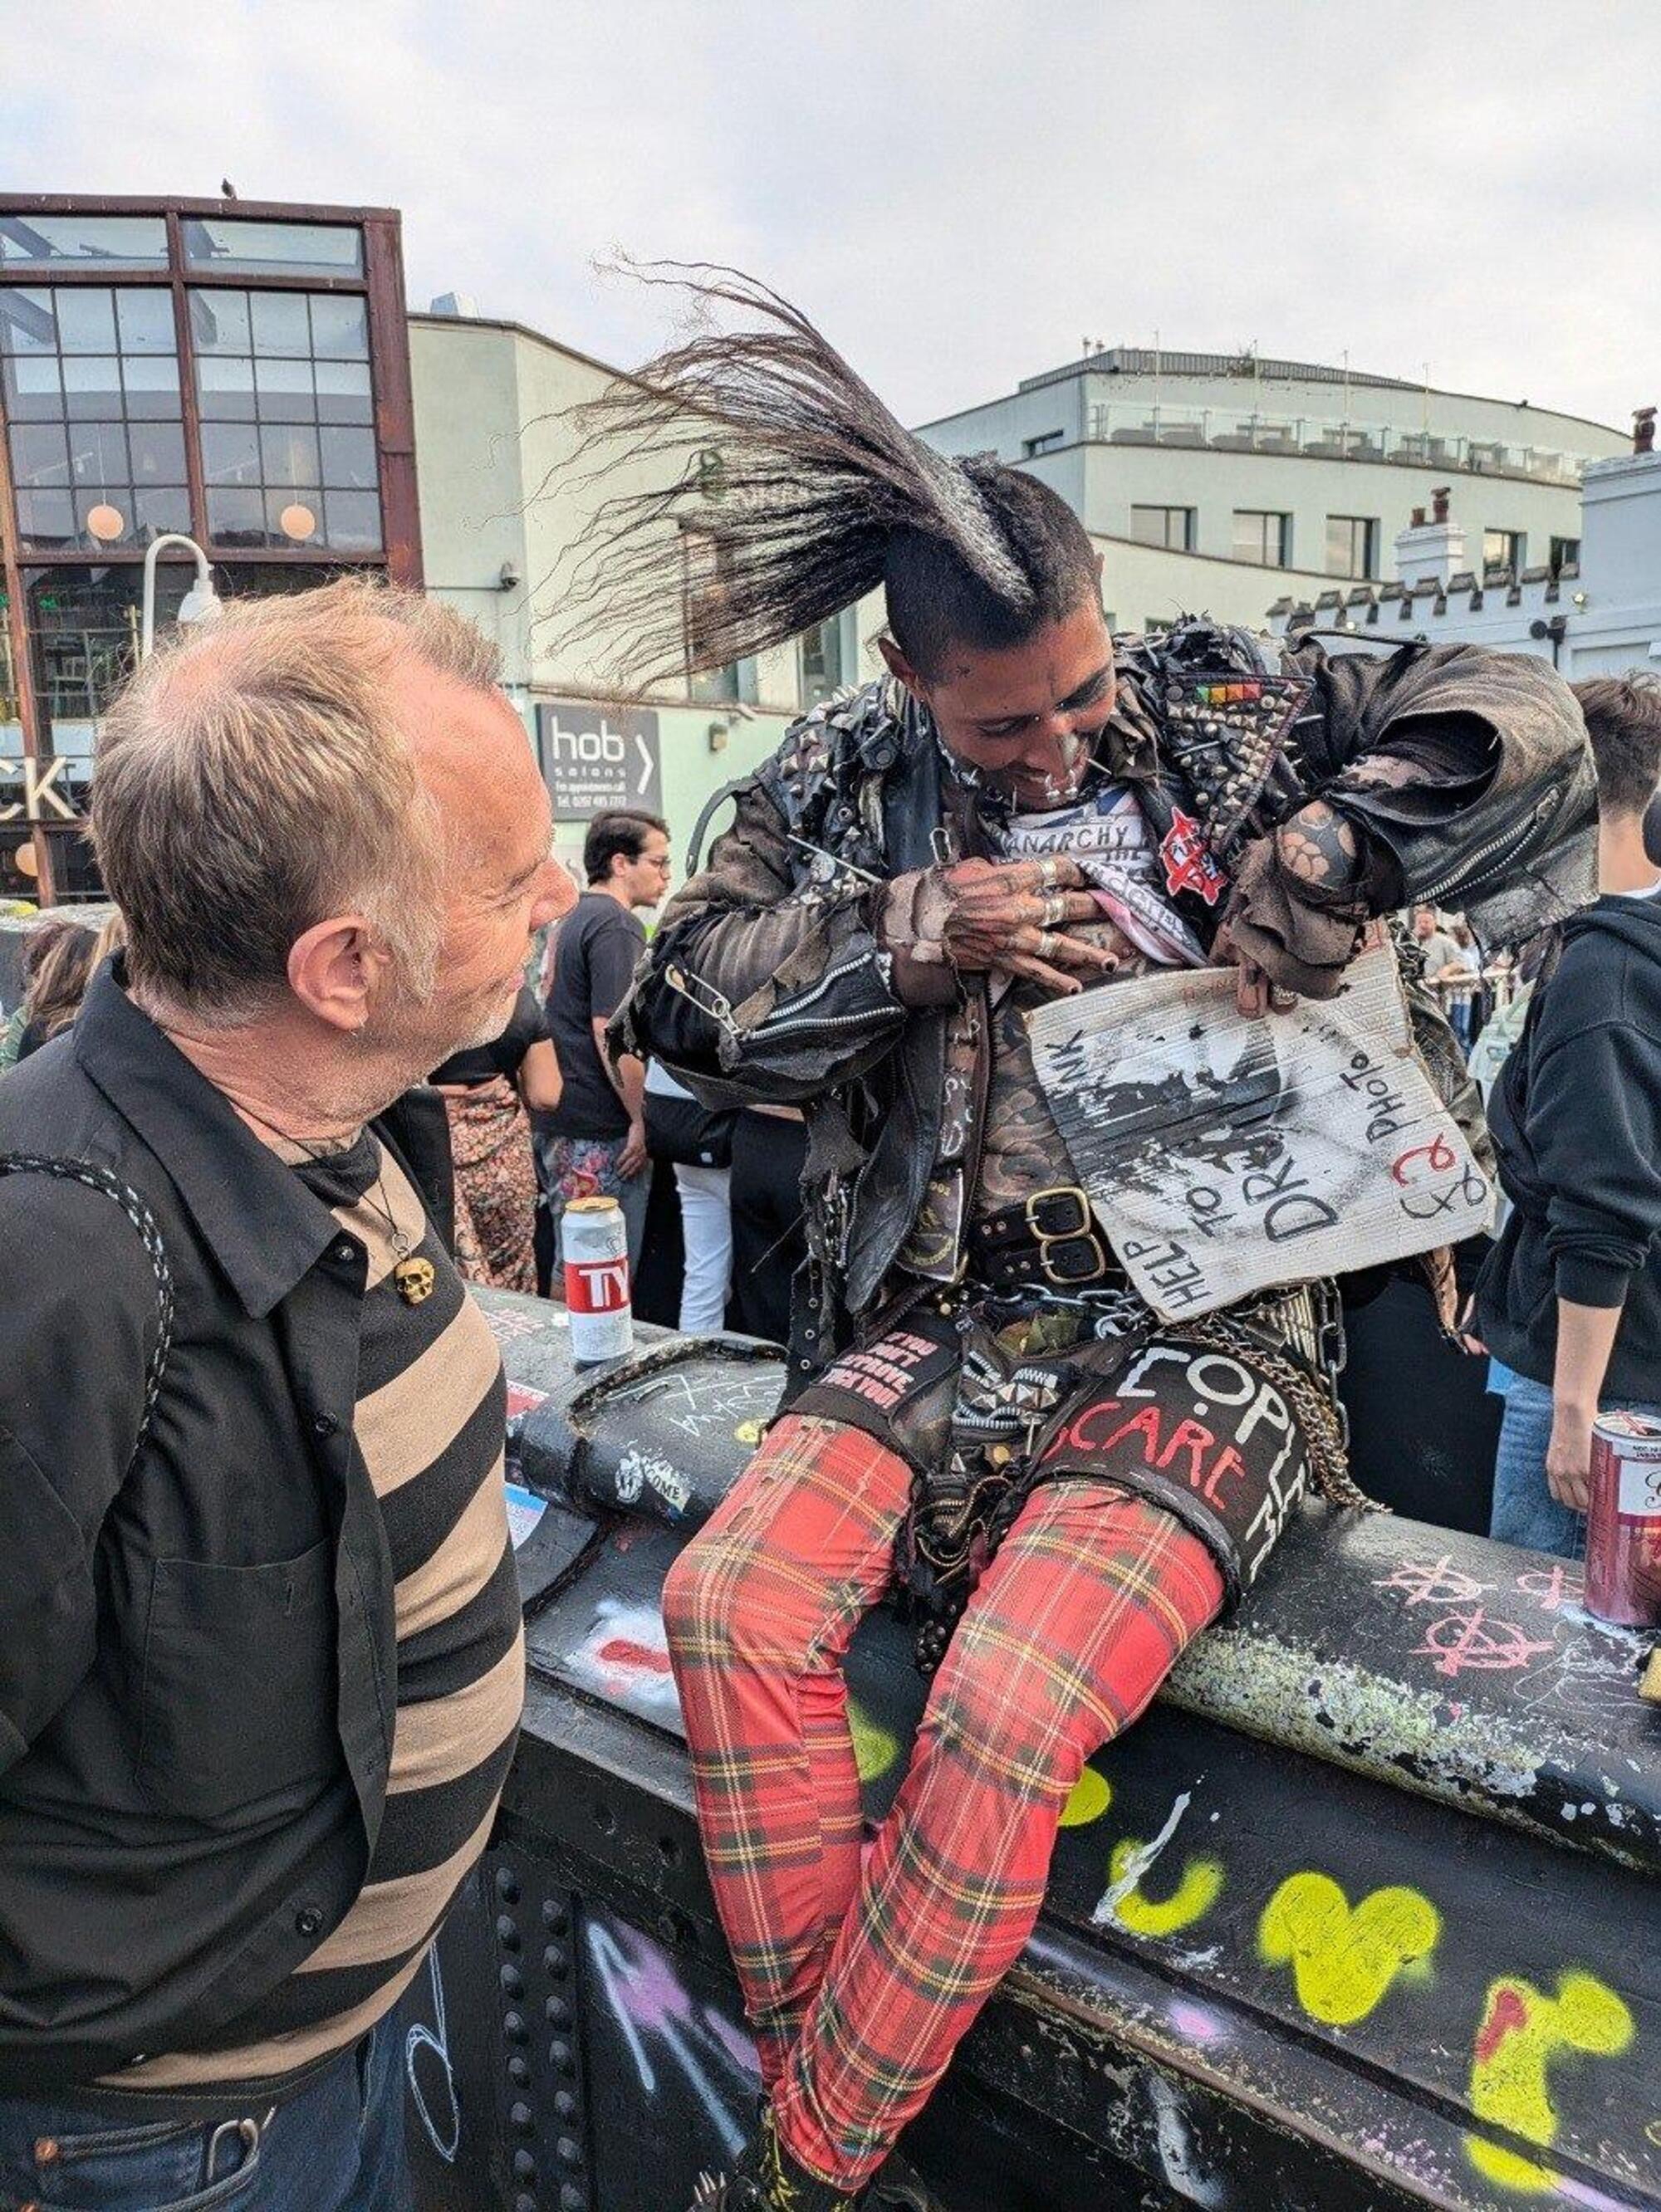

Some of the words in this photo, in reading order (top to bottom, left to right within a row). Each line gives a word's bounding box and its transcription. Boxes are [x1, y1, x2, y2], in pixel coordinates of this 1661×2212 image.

[551, 716, 625, 761] hob
[1007, 825, 1128, 857] ANARCHY
[1339, 1050, 1422, 1143] PHOTO
[1186, 1186, 1238, 1237] TO
[1122, 1241, 1213, 1309] HELP
